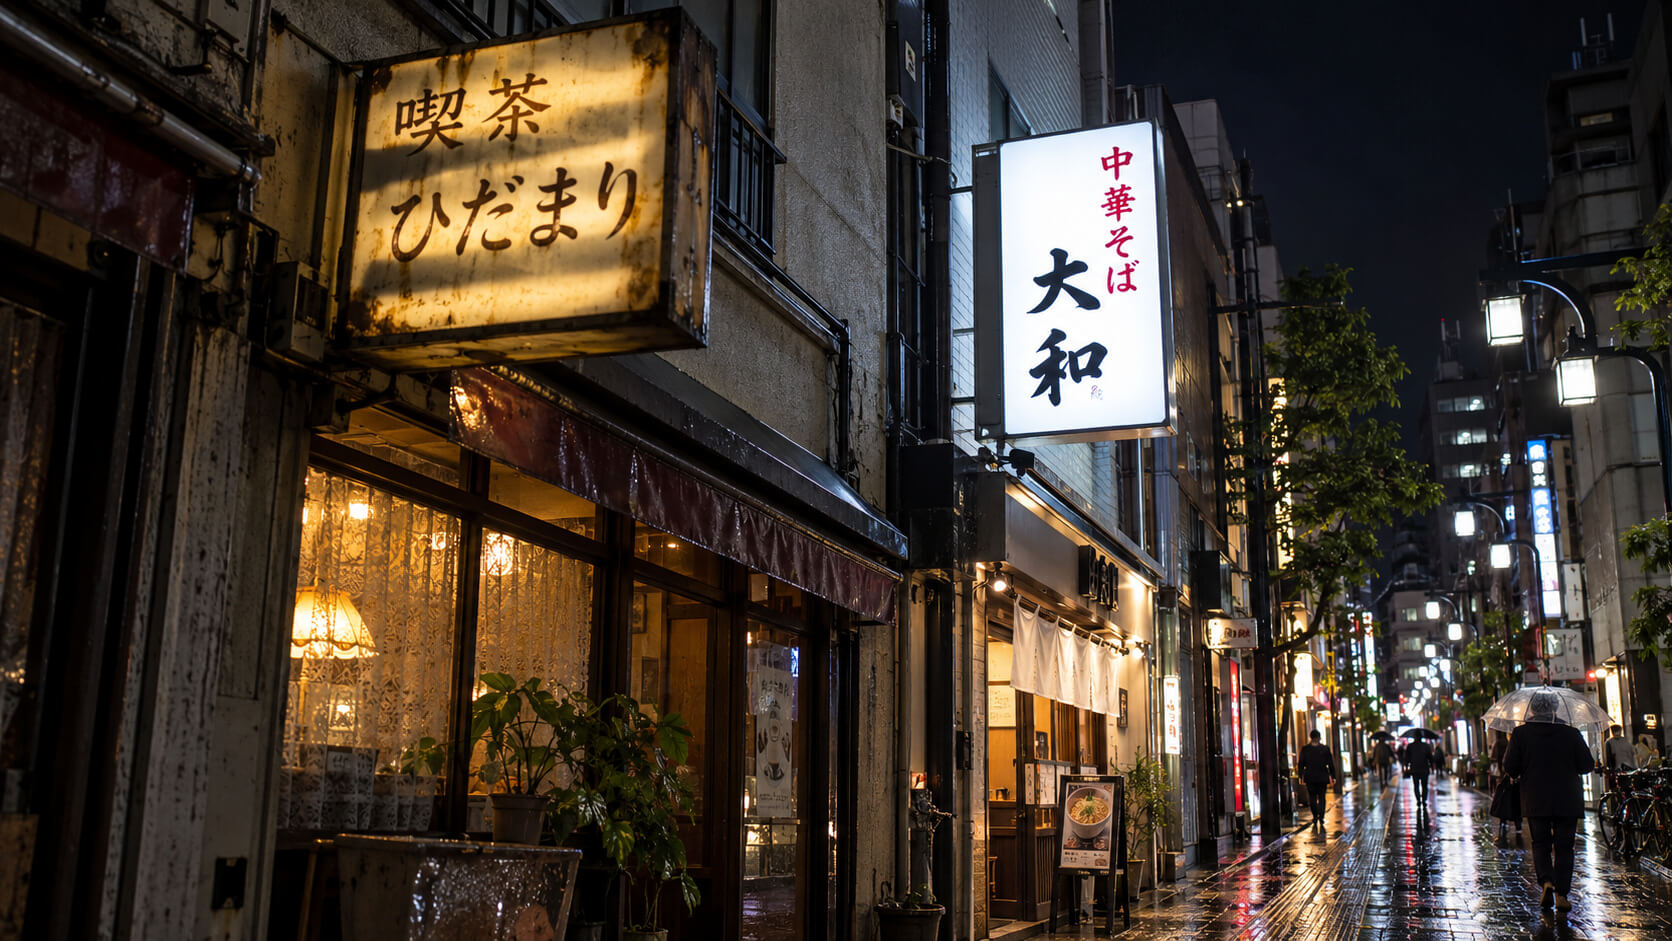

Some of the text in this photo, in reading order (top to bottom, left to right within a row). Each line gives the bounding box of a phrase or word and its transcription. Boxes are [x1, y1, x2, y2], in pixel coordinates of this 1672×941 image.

[395, 73, 552, 156] 喫茶
[391, 161, 637, 262] ひだまり
[1101, 146, 1140, 294] 中華そば
[1026, 248, 1108, 407] 大和
